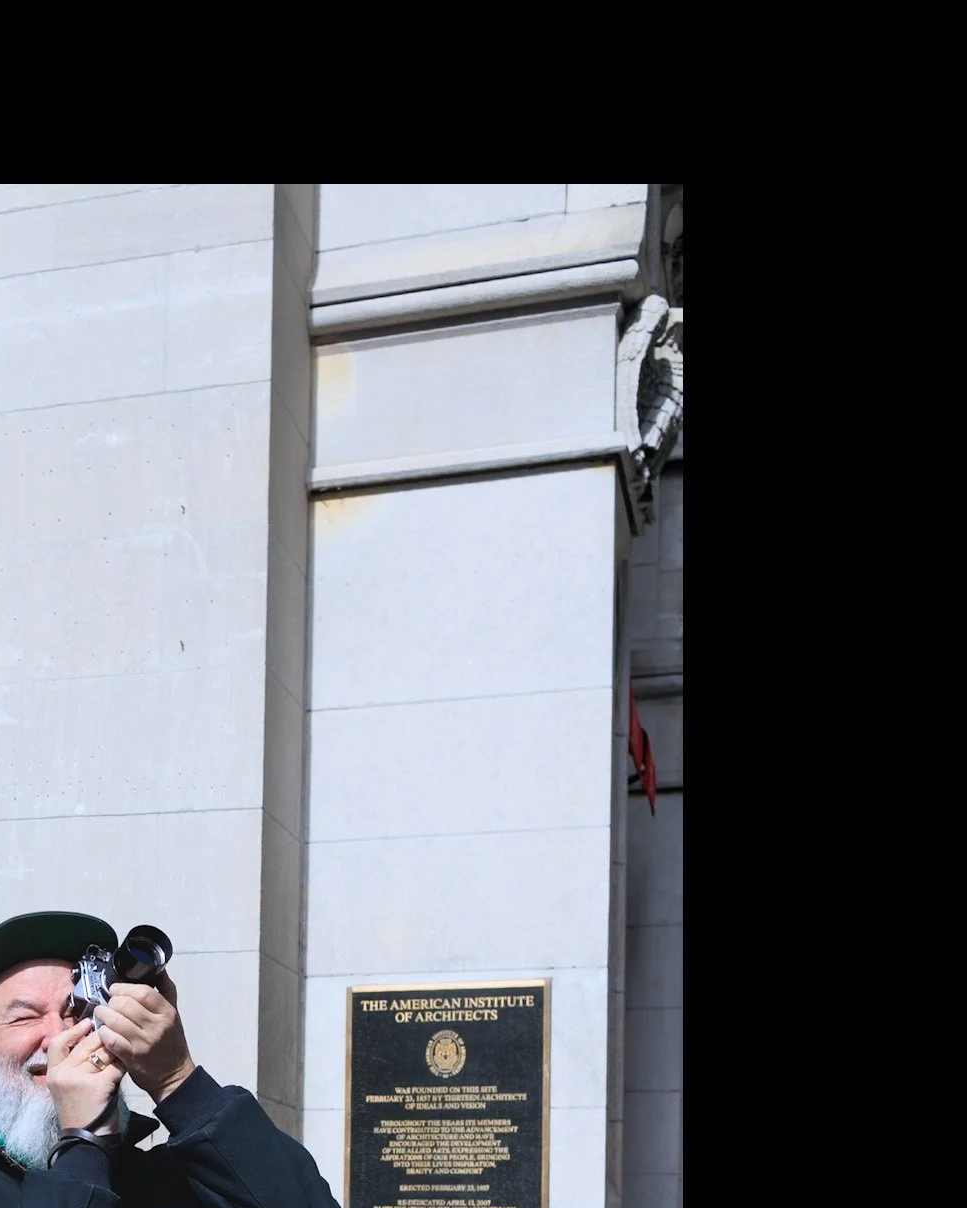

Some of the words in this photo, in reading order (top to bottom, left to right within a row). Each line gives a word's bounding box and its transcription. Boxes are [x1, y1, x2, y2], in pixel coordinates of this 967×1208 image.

[361, 1000, 387, 1011] THE
[390, 998, 461, 1010] AMERICAN
[464, 996, 534, 1008] INSTITUTE
[395, 1012, 413, 1023] OF
[415, 1009, 498, 1022] ARCHITECTS
[412, 1086, 448, 1094] FOUNDED
[480, 1085, 497, 1093] SITE
[366, 1095, 404, 1103] FEBRUARY
[480, 1093, 527, 1101] ARCHITECTS
